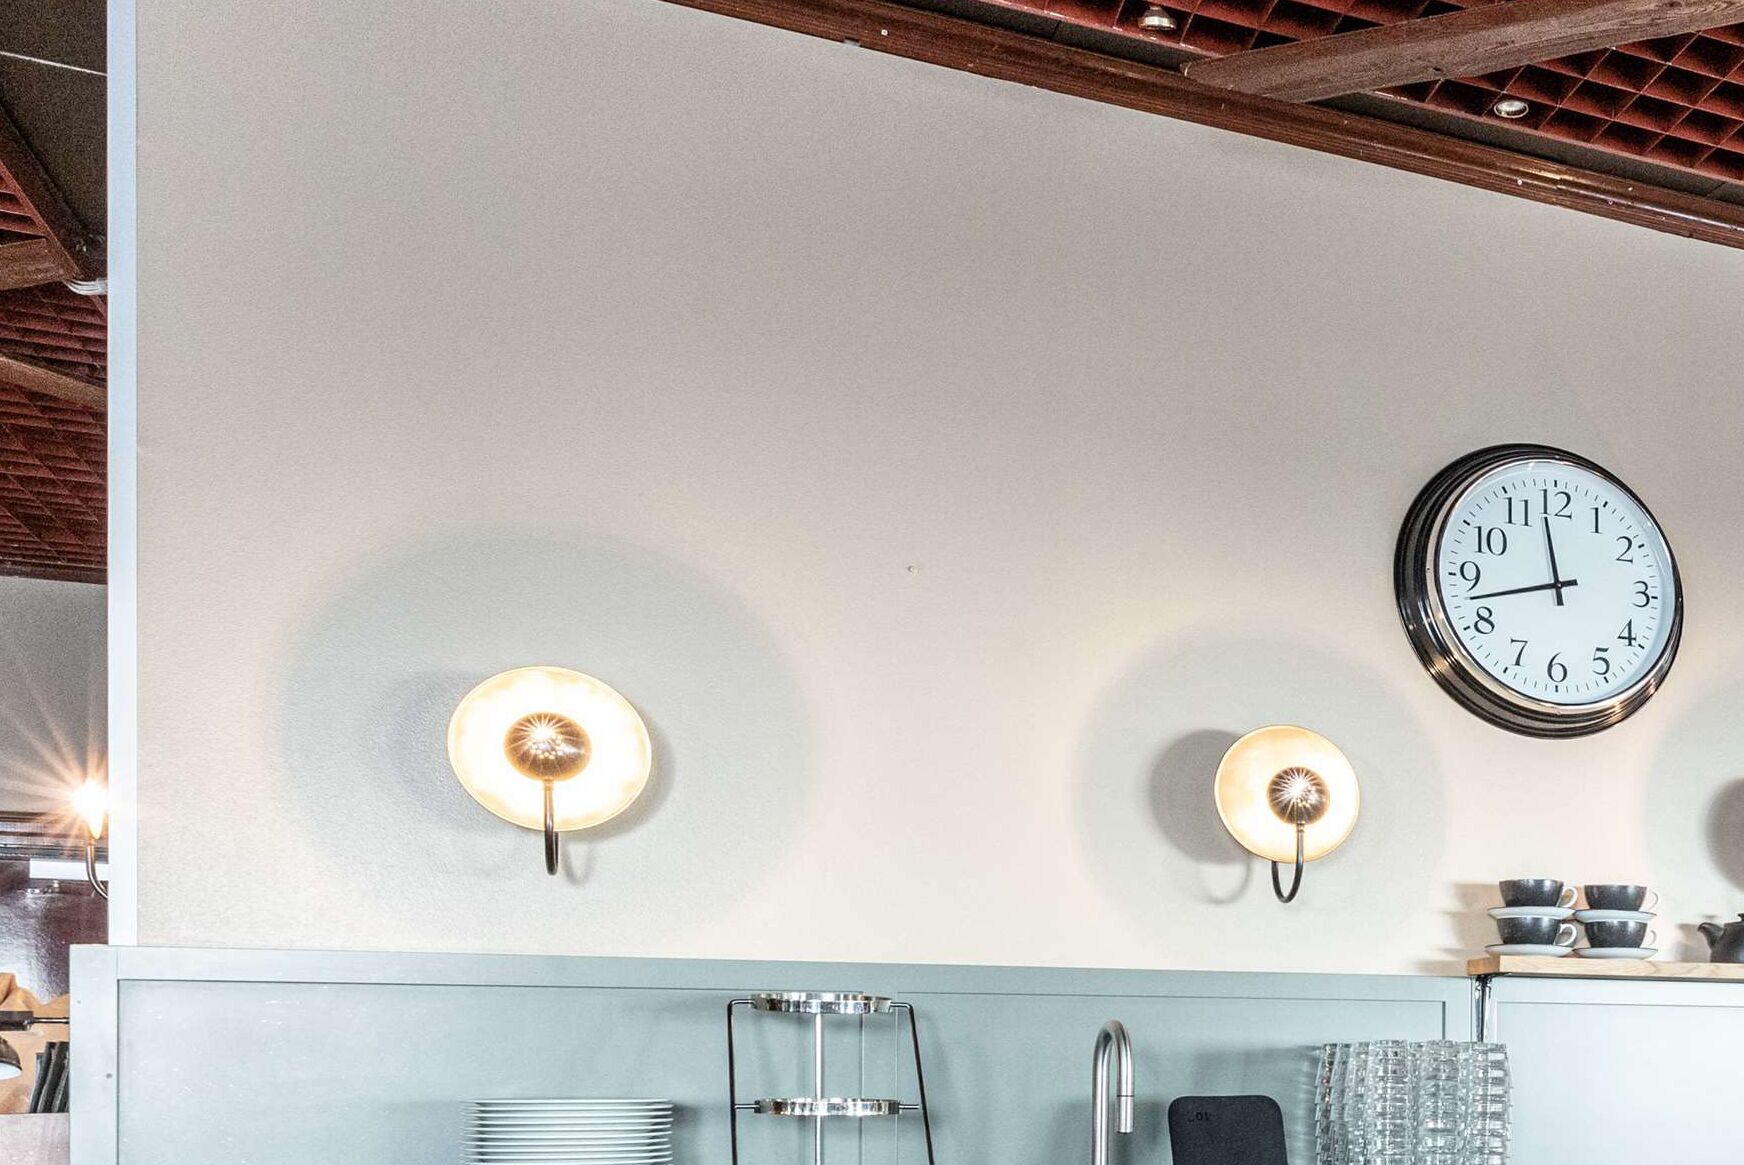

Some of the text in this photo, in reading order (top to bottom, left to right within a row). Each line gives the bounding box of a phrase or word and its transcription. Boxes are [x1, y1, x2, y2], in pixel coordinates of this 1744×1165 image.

[1503, 497, 1533, 527] 11
[1539, 489, 1573, 520] 12
[1590, 507, 1603, 535] 1
[1474, 525, 1508, 556] 10
[1615, 535, 1634, 563] 2
[1459, 560, 1481, 592] 9
[1631, 580, 1651, 608] 3
[1473, 606, 1496, 635] 8
[1617, 618, 1638, 647] 4
[1510, 637, 1529, 668] 7
[1546, 652, 1568, 683] 6
[1591, 646, 1611, 676] 5
